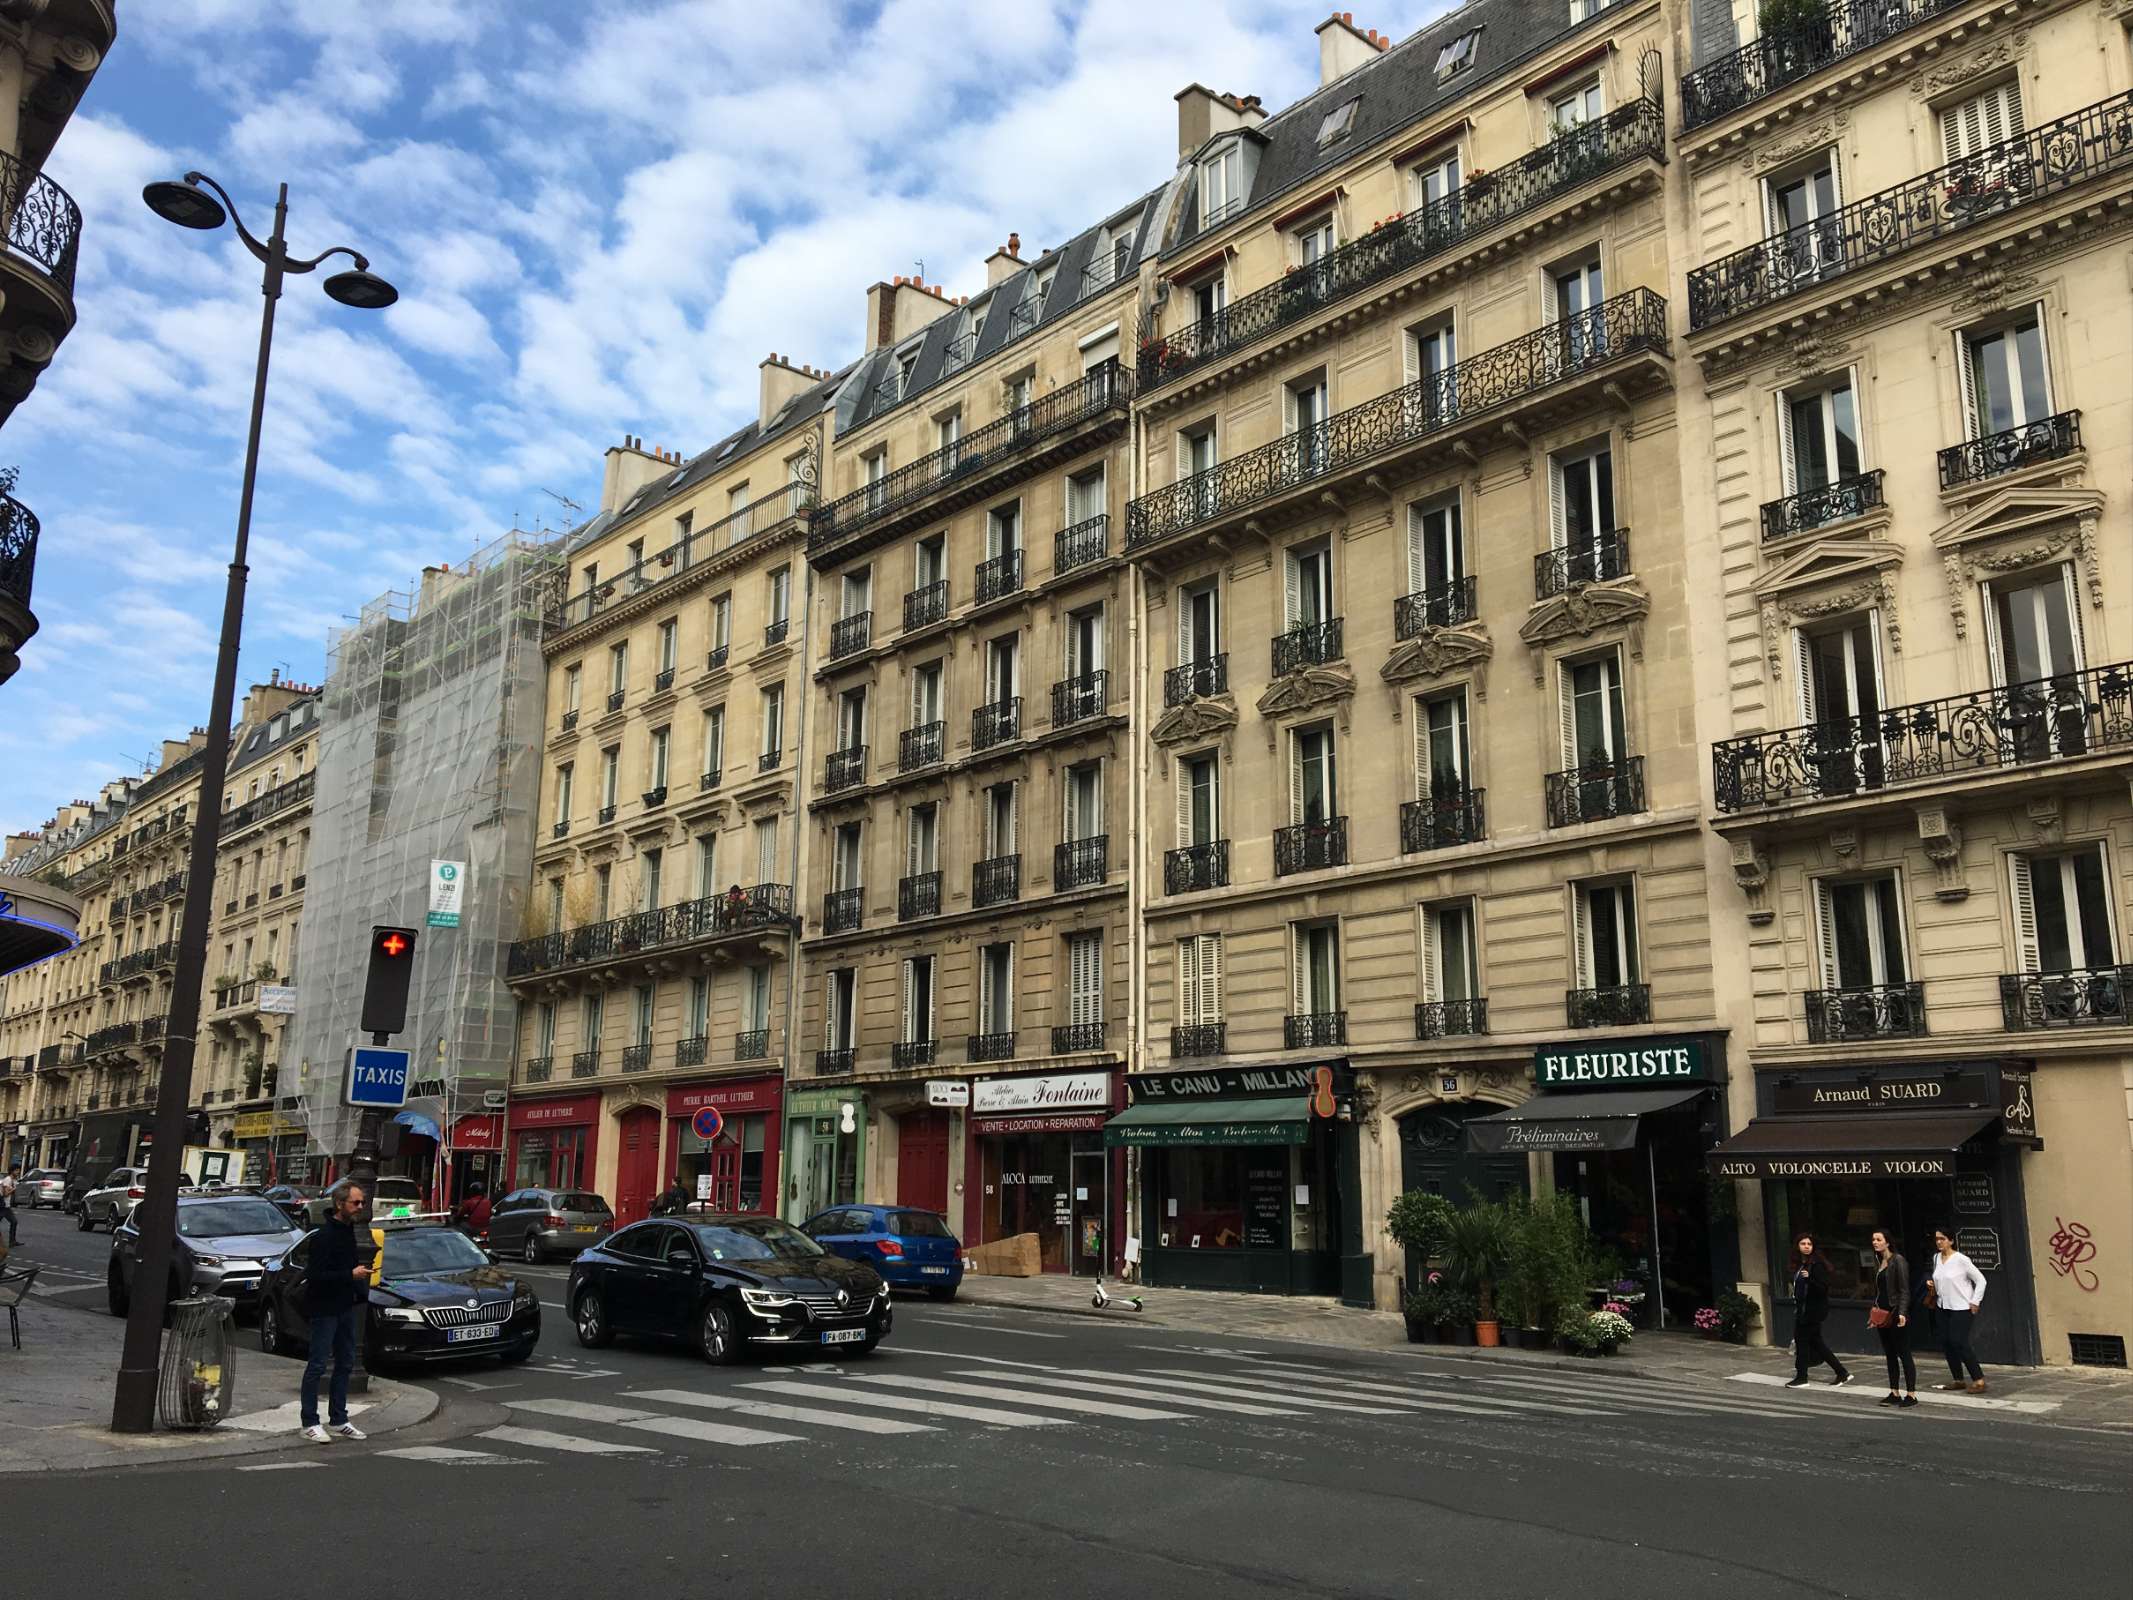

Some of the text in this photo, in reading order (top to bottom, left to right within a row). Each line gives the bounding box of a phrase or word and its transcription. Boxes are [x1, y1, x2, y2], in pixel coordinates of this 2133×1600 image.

[1545, 1047, 1692, 1082] FLEURISTE
[356, 1066, 404, 1085] TAXIS
[1141, 1079, 1166, 1097] LE
[1171, 1075, 1221, 1095] CANU
[1241, 1068, 1313, 1092] MILLAN
[1444, 1079, 1455, 1090] 56
[1033, 1079, 1104, 1104] Fontaine
[1814, 1082, 1942, 1102] Arnaud SUARD
[981, 1117, 1096, 1132] VENTE LOCATION REPARATION
[1506, 1124, 1600, 1144] Préliminaires
[1720, 1160, 1944, 1175] ALTO VIOLONCELLE VIOLON
